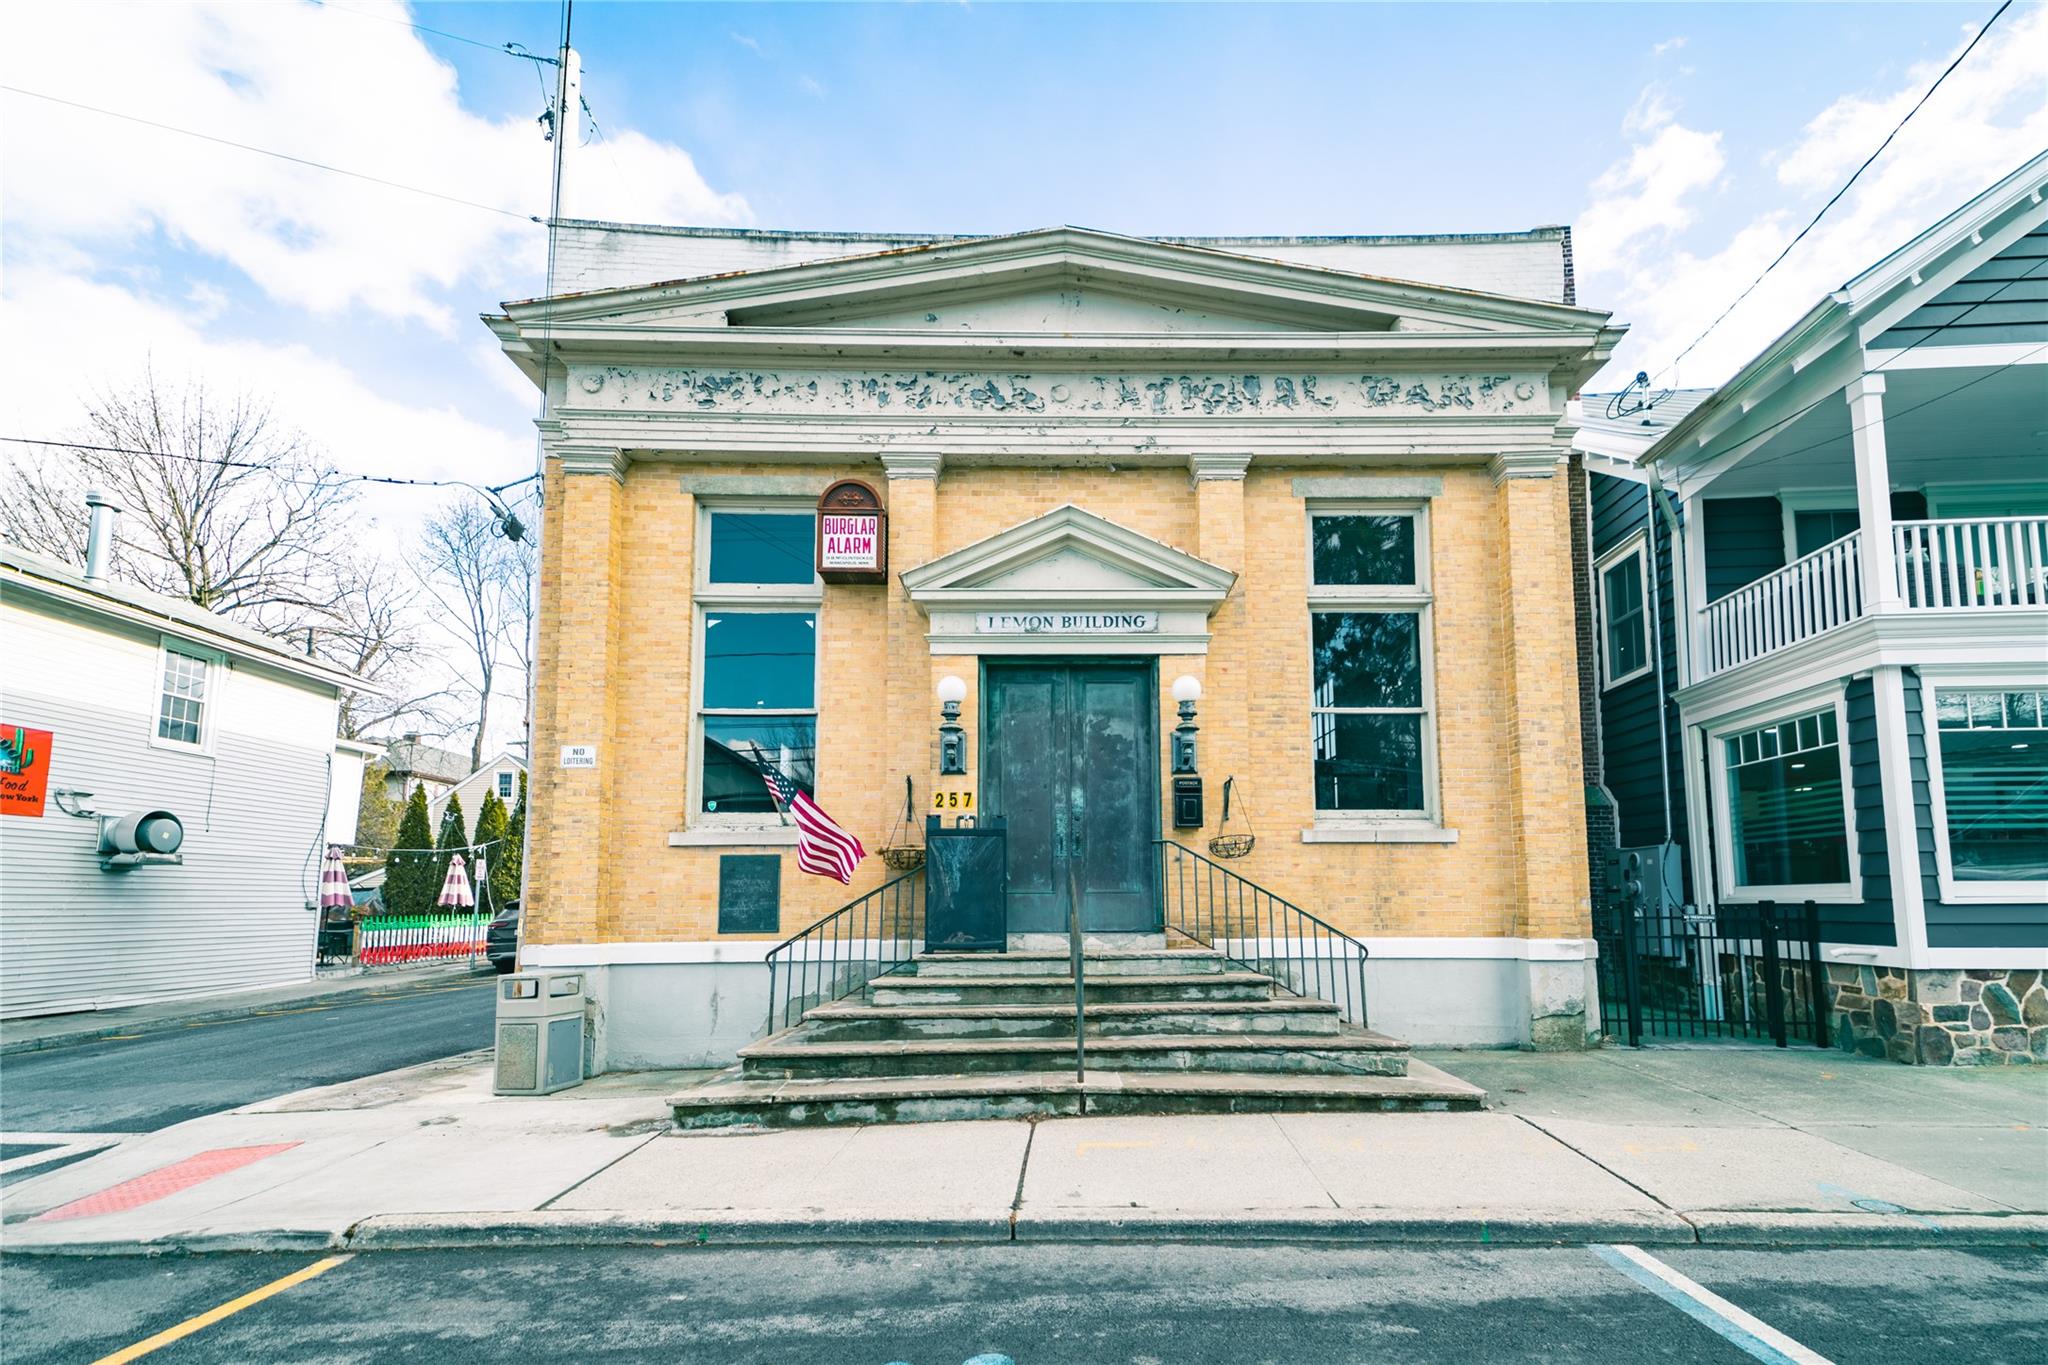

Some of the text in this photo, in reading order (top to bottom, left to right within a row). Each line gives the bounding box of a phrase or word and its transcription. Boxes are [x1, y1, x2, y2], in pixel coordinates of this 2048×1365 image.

[824, 517, 876, 535] BURGLAR
[827, 537, 871, 554] ALARM
[1061, 615, 1146, 629] BUILDING
[572, 748, 585, 756] NO
[563, 757, 594, 765] LOITERING
[16, 793, 39, 803] York
[935, 792, 973, 808] 257
